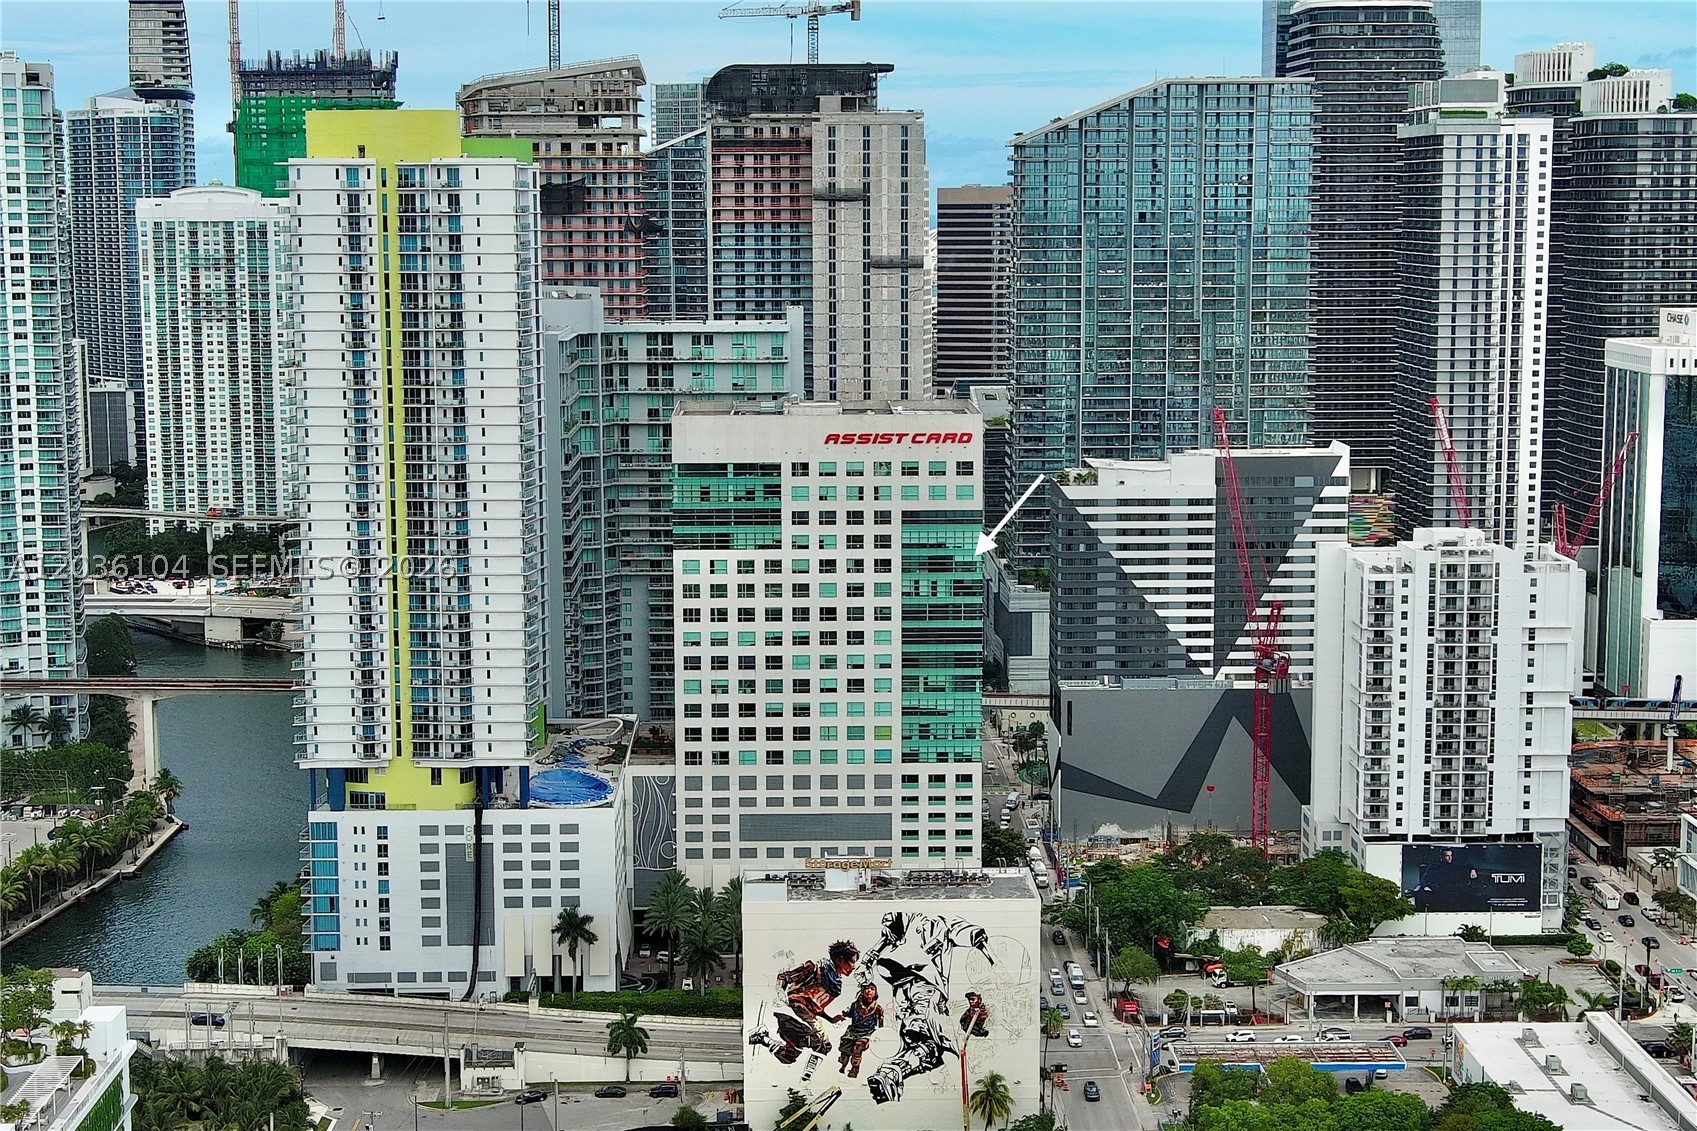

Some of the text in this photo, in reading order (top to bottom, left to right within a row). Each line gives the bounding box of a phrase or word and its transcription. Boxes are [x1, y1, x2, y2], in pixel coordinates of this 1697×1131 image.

[1666, 313, 1684, 325] CHASE
[824, 433, 973, 445] ASSIST CARD
[465, 825, 473, 859] CORE
[805, 857, 893, 872] StorageMart
[1491, 873, 1526, 884] TUMI
